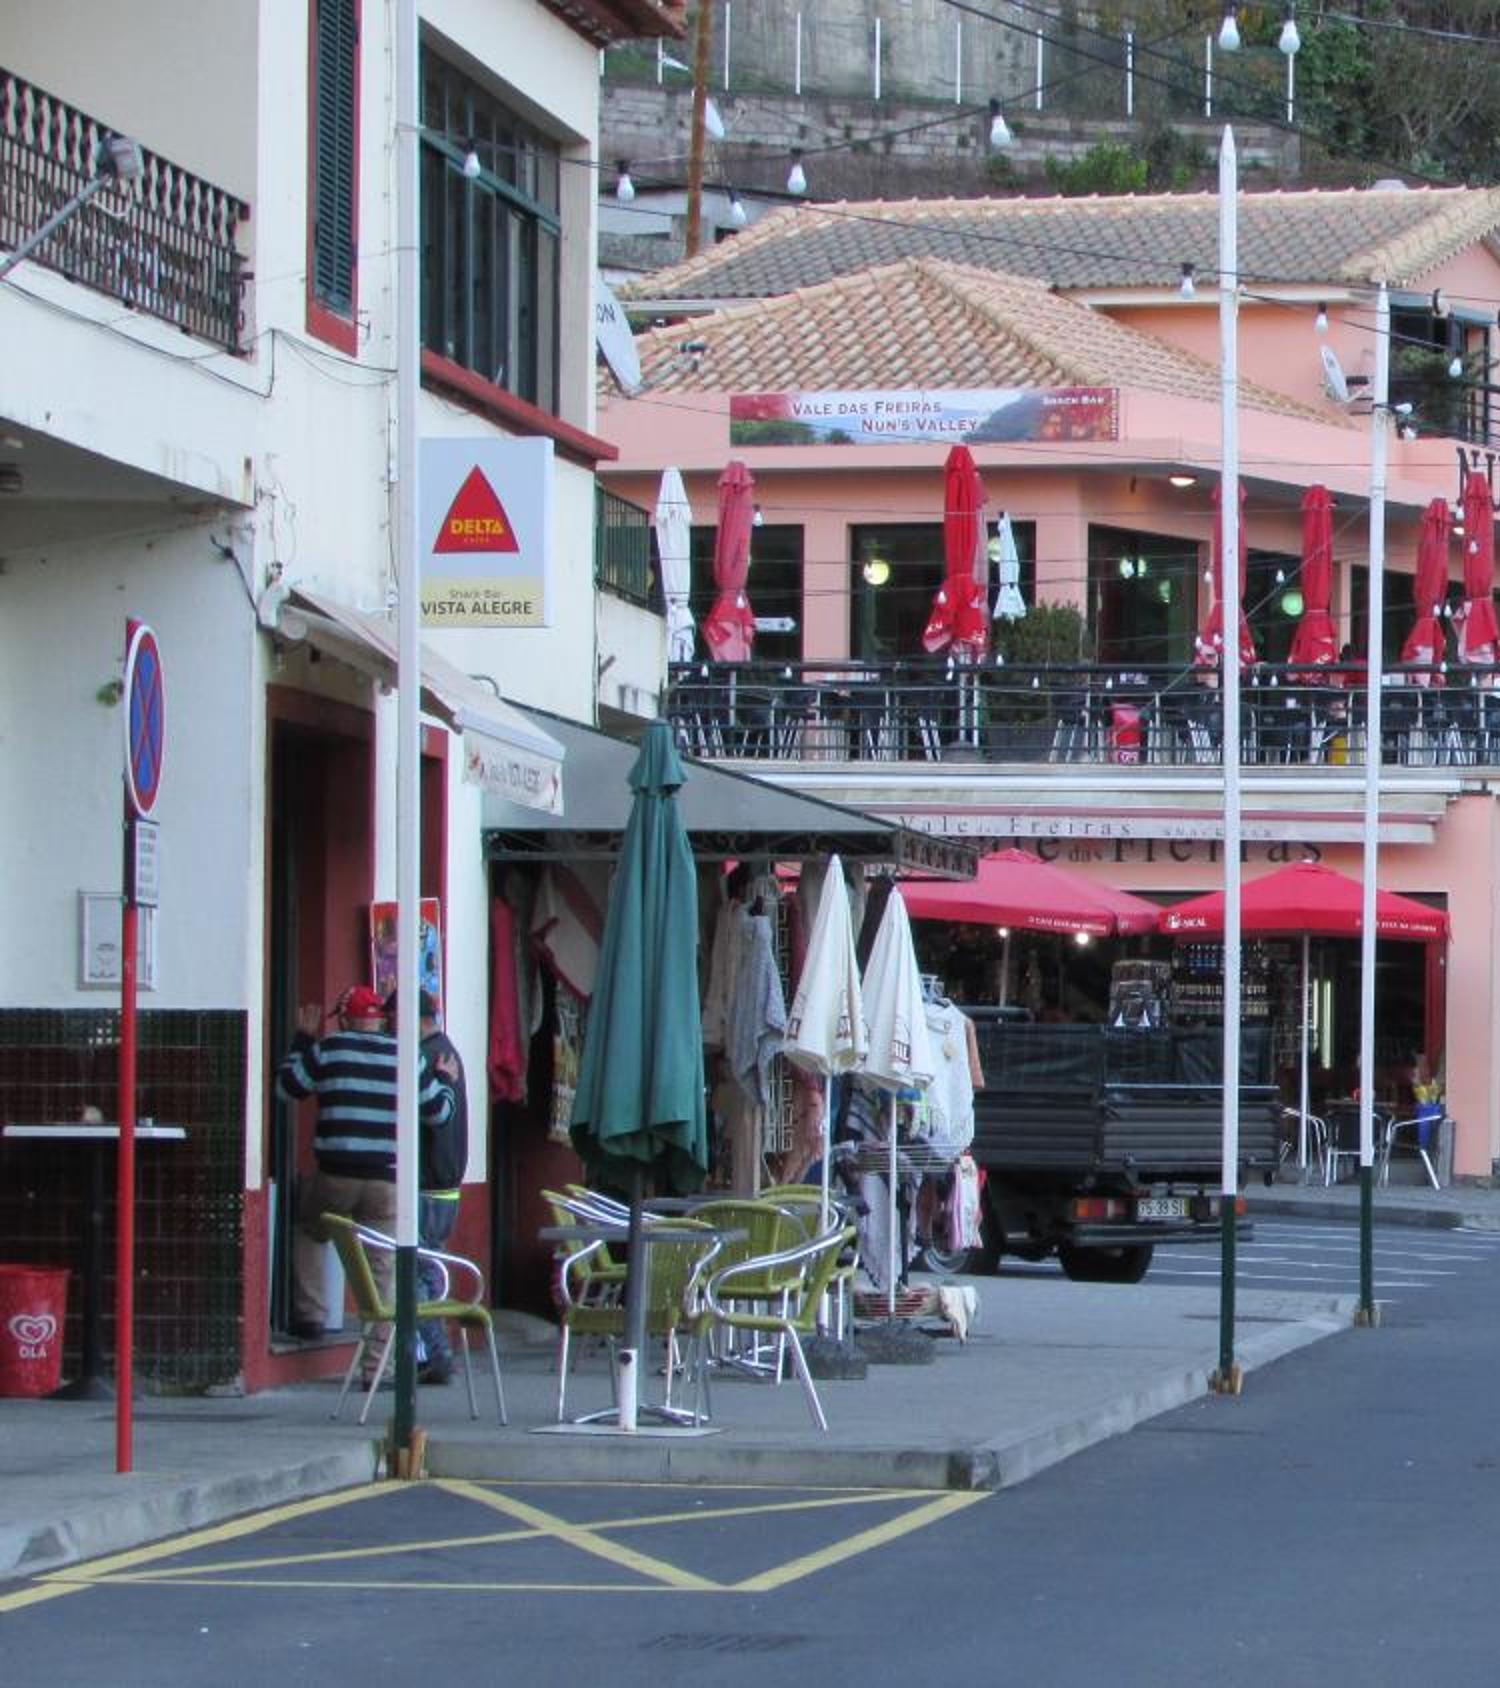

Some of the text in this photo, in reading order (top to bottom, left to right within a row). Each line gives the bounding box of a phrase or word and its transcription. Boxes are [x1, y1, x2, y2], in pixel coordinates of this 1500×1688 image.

[793, 401, 942, 415] VALE DAS FREIRAS
[862, 419, 977, 432] NUN'S VALLEY
[451, 519, 504, 534] DELTA
[421, 602, 533, 614] VISTA ALEGRE
[1010, 817, 1132, 835] Freiras
